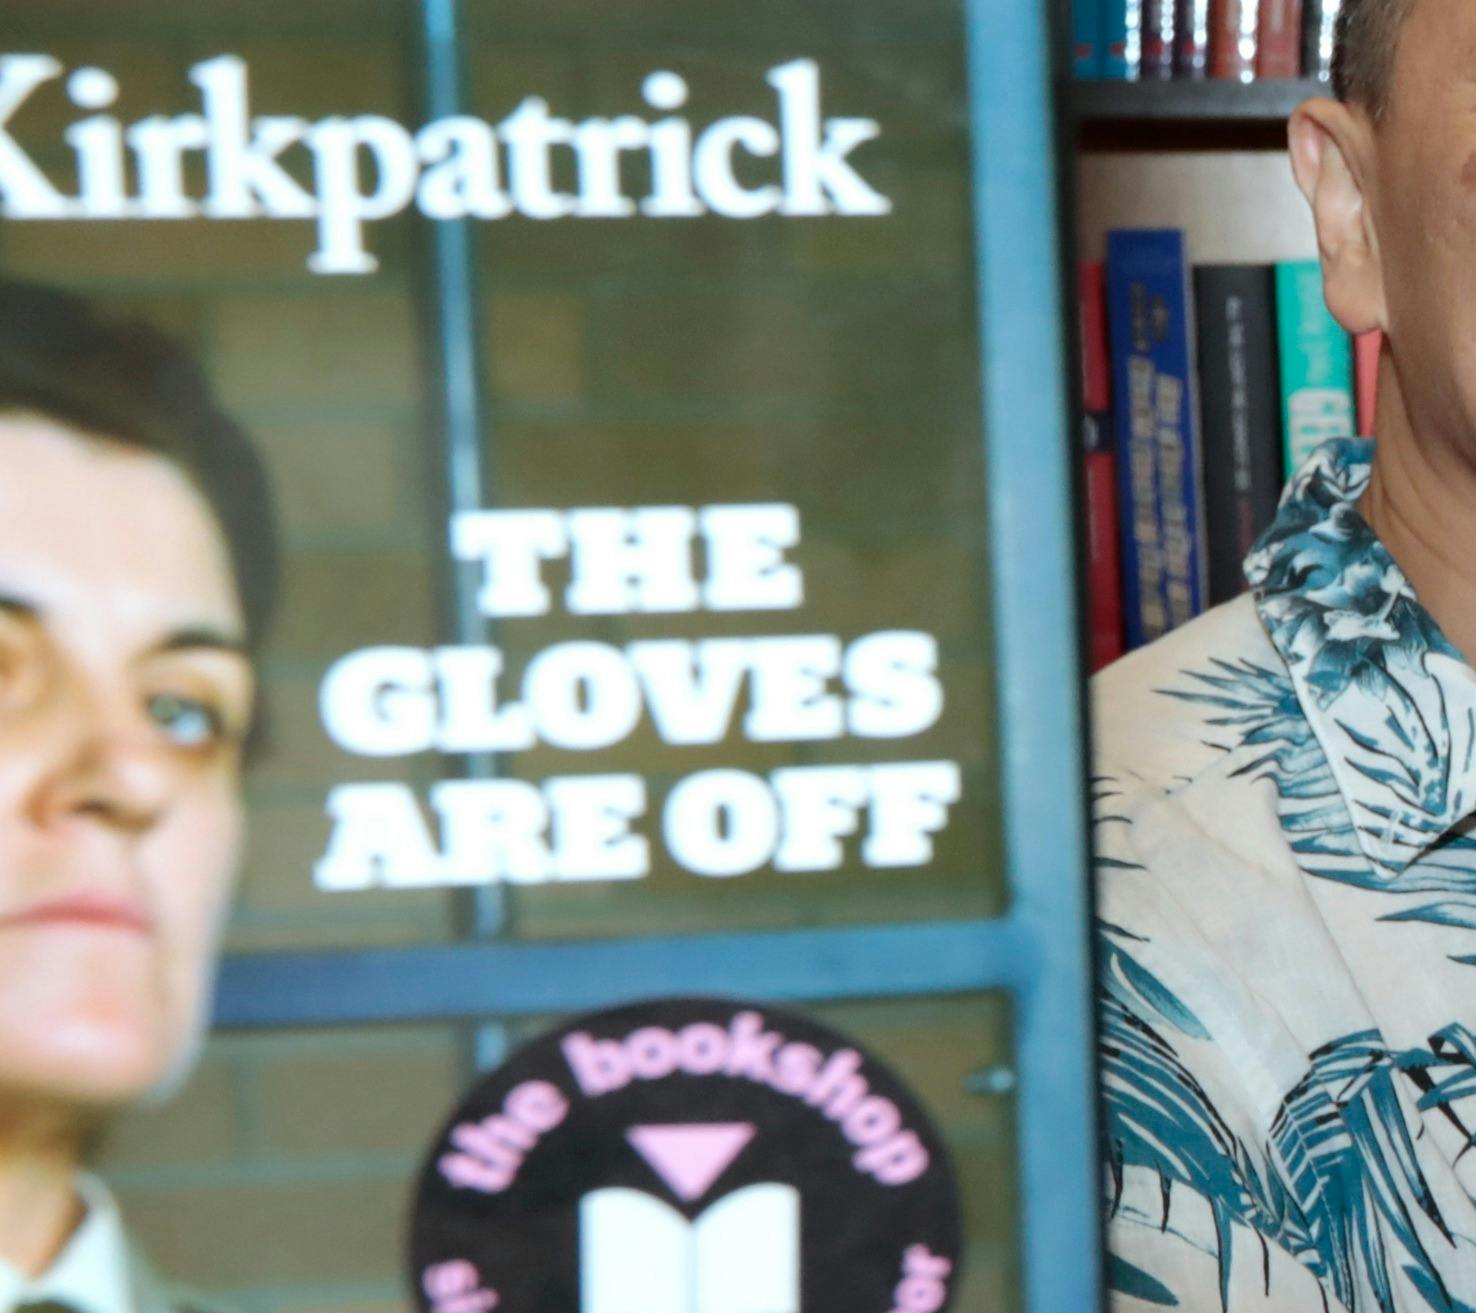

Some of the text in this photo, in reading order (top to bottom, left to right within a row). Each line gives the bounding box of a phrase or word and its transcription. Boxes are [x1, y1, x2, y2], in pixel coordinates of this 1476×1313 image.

[449, 502, 804, 618] THE
[317, 630, 944, 757] GLOVES
[312, 759, 962, 890] ARE OFF
[435, 1010, 932, 1197] the bookshop
